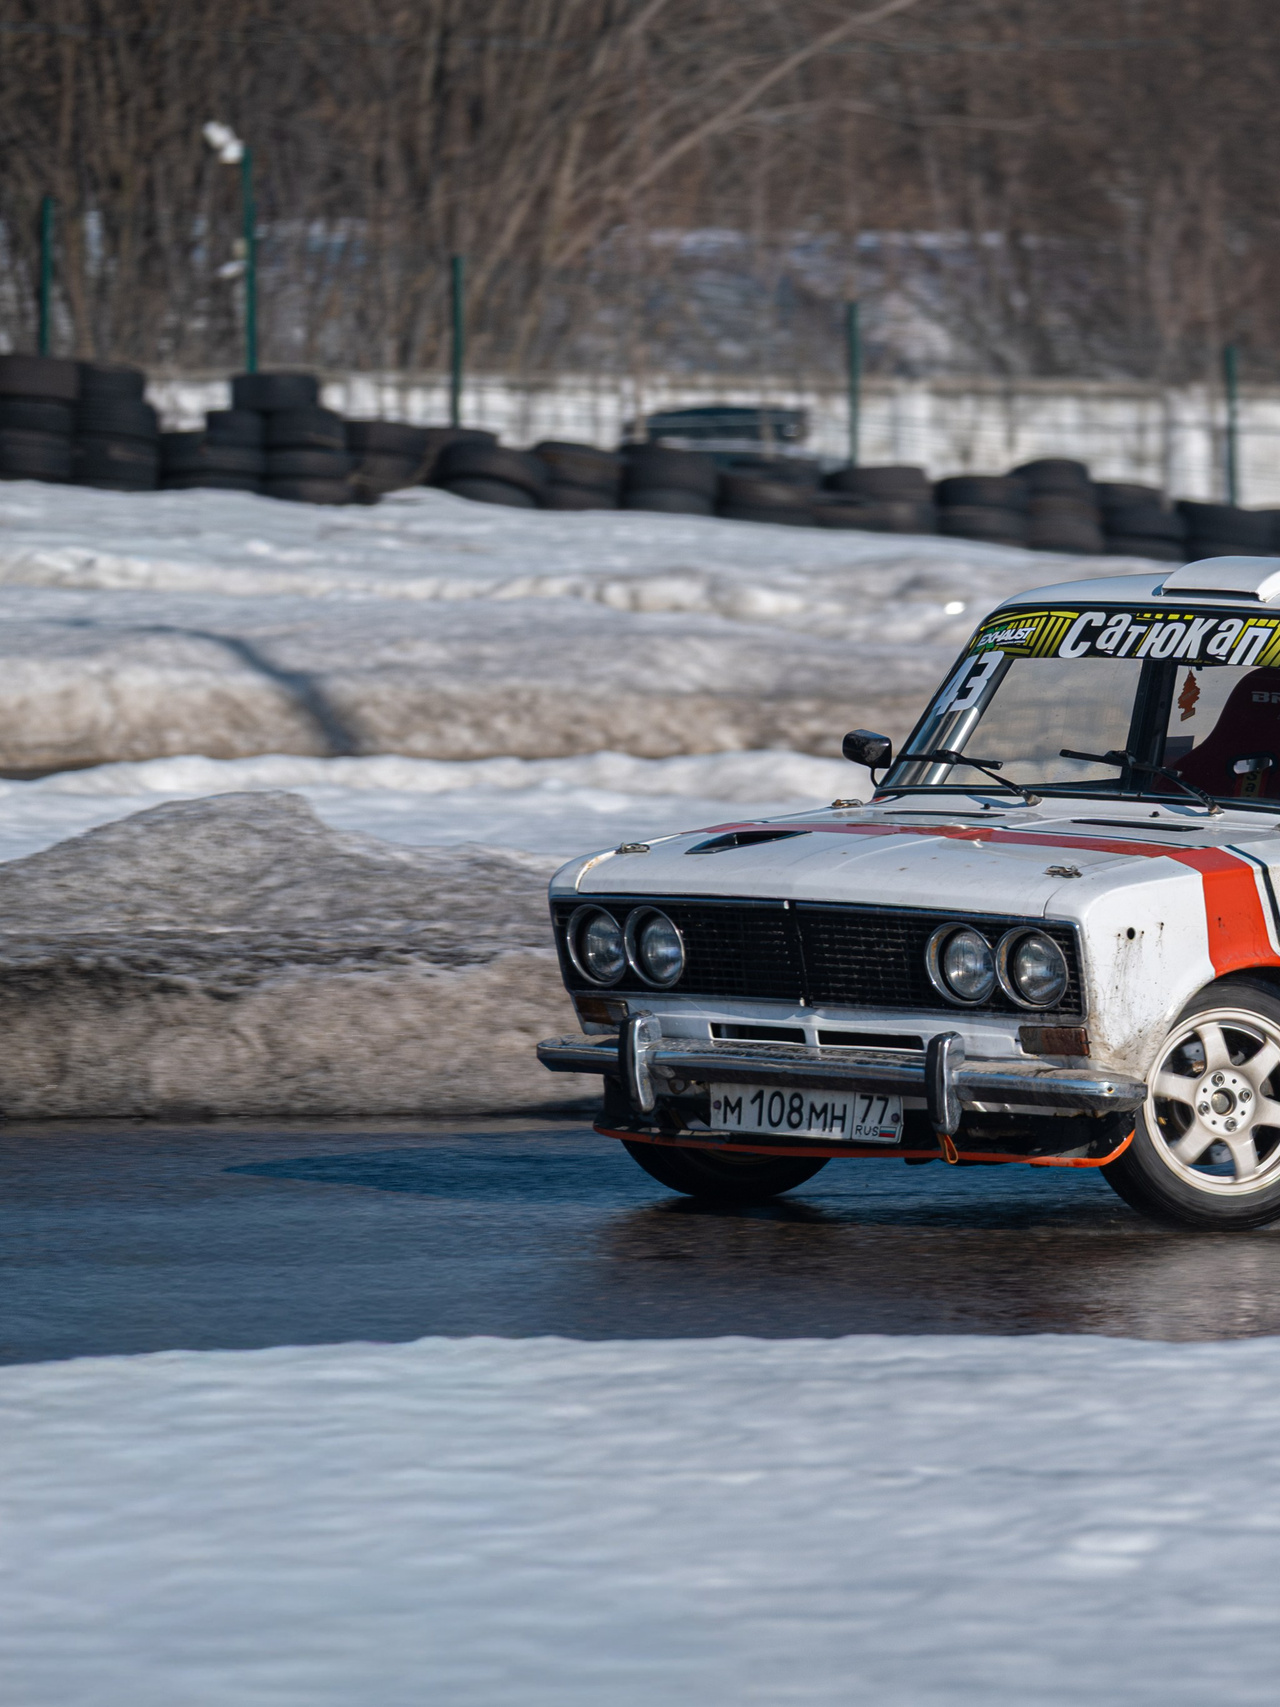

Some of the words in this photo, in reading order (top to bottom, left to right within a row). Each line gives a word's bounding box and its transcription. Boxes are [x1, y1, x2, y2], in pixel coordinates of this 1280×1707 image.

[976, 627, 1037, 647] EXHAUST
[859, 1095, 890, 1125] 77
[854, 1124, 880, 1137] RUS
